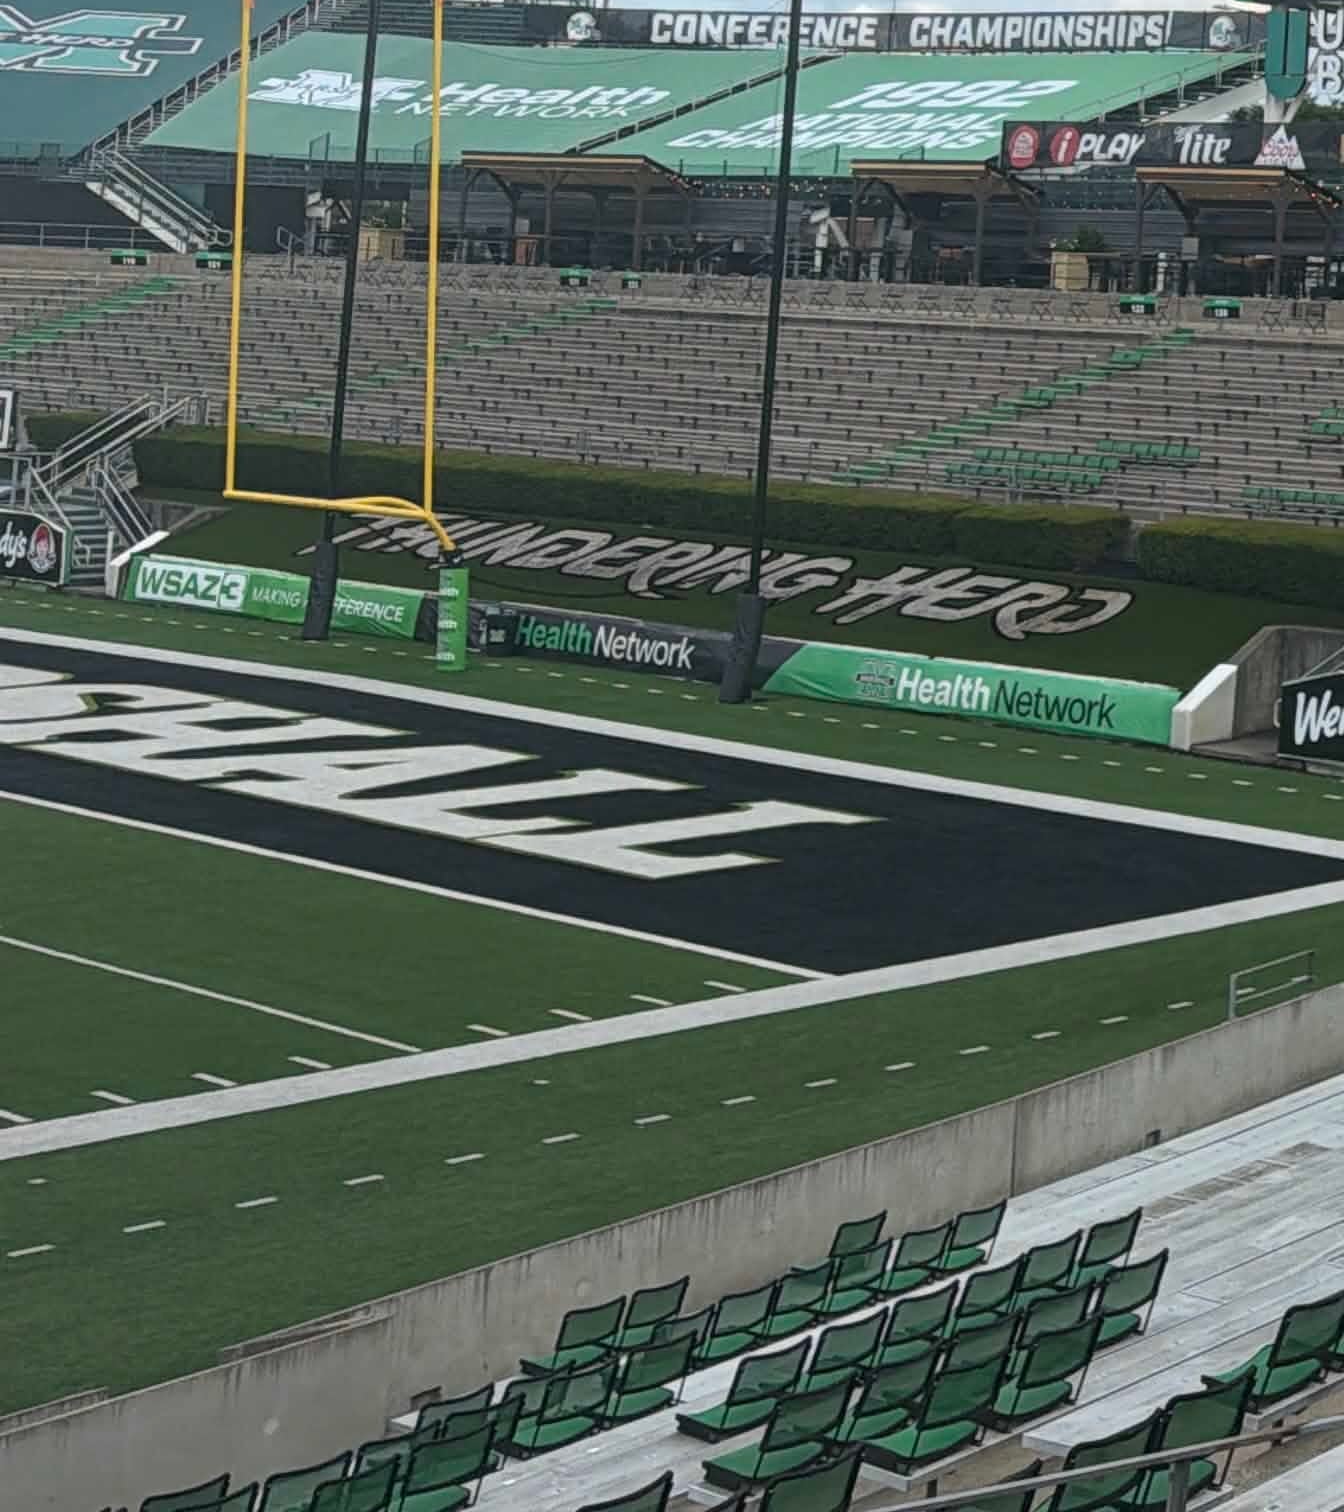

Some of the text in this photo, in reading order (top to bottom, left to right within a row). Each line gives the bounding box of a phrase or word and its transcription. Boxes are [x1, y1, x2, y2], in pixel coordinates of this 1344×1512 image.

[651, 12, 1166, 48] CONFERENCE CHAMPIONSHIPS
[396, 102, 632, 119] NETWORK
[418, 81, 671, 105] Health
[827, 79, 1079, 109] 1992
[740, 112, 1008, 131] NATIONAL
[667, 129, 1003, 151] CHAMPIONS
[0, 521, 28, 568] dy's
[140, 569, 246, 608] WSAZ 3
[295, 512, 1135, 640] THUNDERING HERD
[252, 586, 302, 607] MAKING
[516, 614, 695, 670] Health Network
[896, 666, 990, 713] Health
[993, 679, 1116, 730] Network
[0, 664, 888, 879] SHALL
